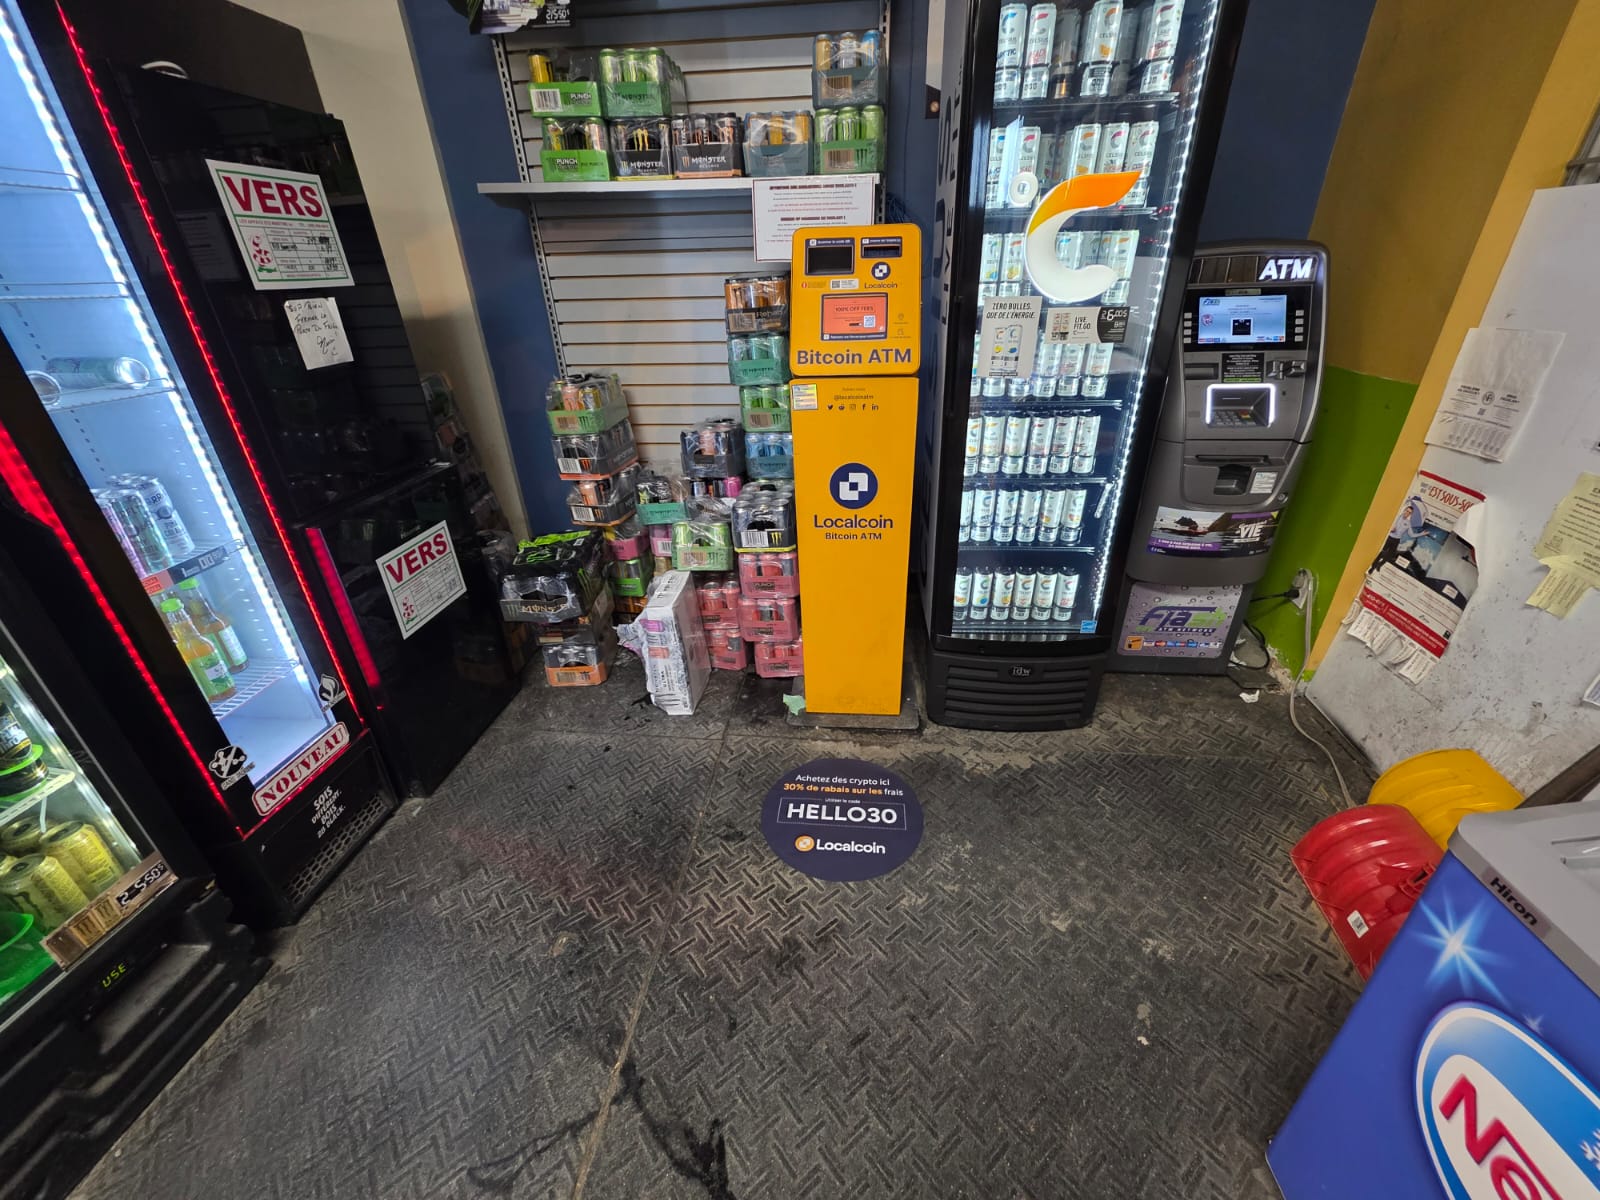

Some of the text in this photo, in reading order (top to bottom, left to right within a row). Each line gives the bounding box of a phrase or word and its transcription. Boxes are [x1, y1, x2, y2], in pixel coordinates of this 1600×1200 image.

[221, 175, 324, 218] VERS
[1258, 257, 1314, 281] ATM
[864, 281, 898, 289] Localcoin
[796, 347, 912, 365] Bitcoin ATM
[813, 514, 894, 529] Localcoin
[825, 532, 882, 540] Bitcoin ATM
[385, 532, 449, 584] VERS
[260, 727, 345, 807] NOUVEAU
[783, 783, 804, 791] 30%
[820, 784, 850, 793] rabais
[869, 786, 883, 795] les
[884, 788, 904, 797] frais
[795, 774, 890, 787] Achetez des crypto ici
[313, 785, 333, 810] SOIS
[787, 803, 898, 824] HELLO30
[815, 838, 886, 855] Localcoin
[1489, 876, 1539, 927] Hiron
